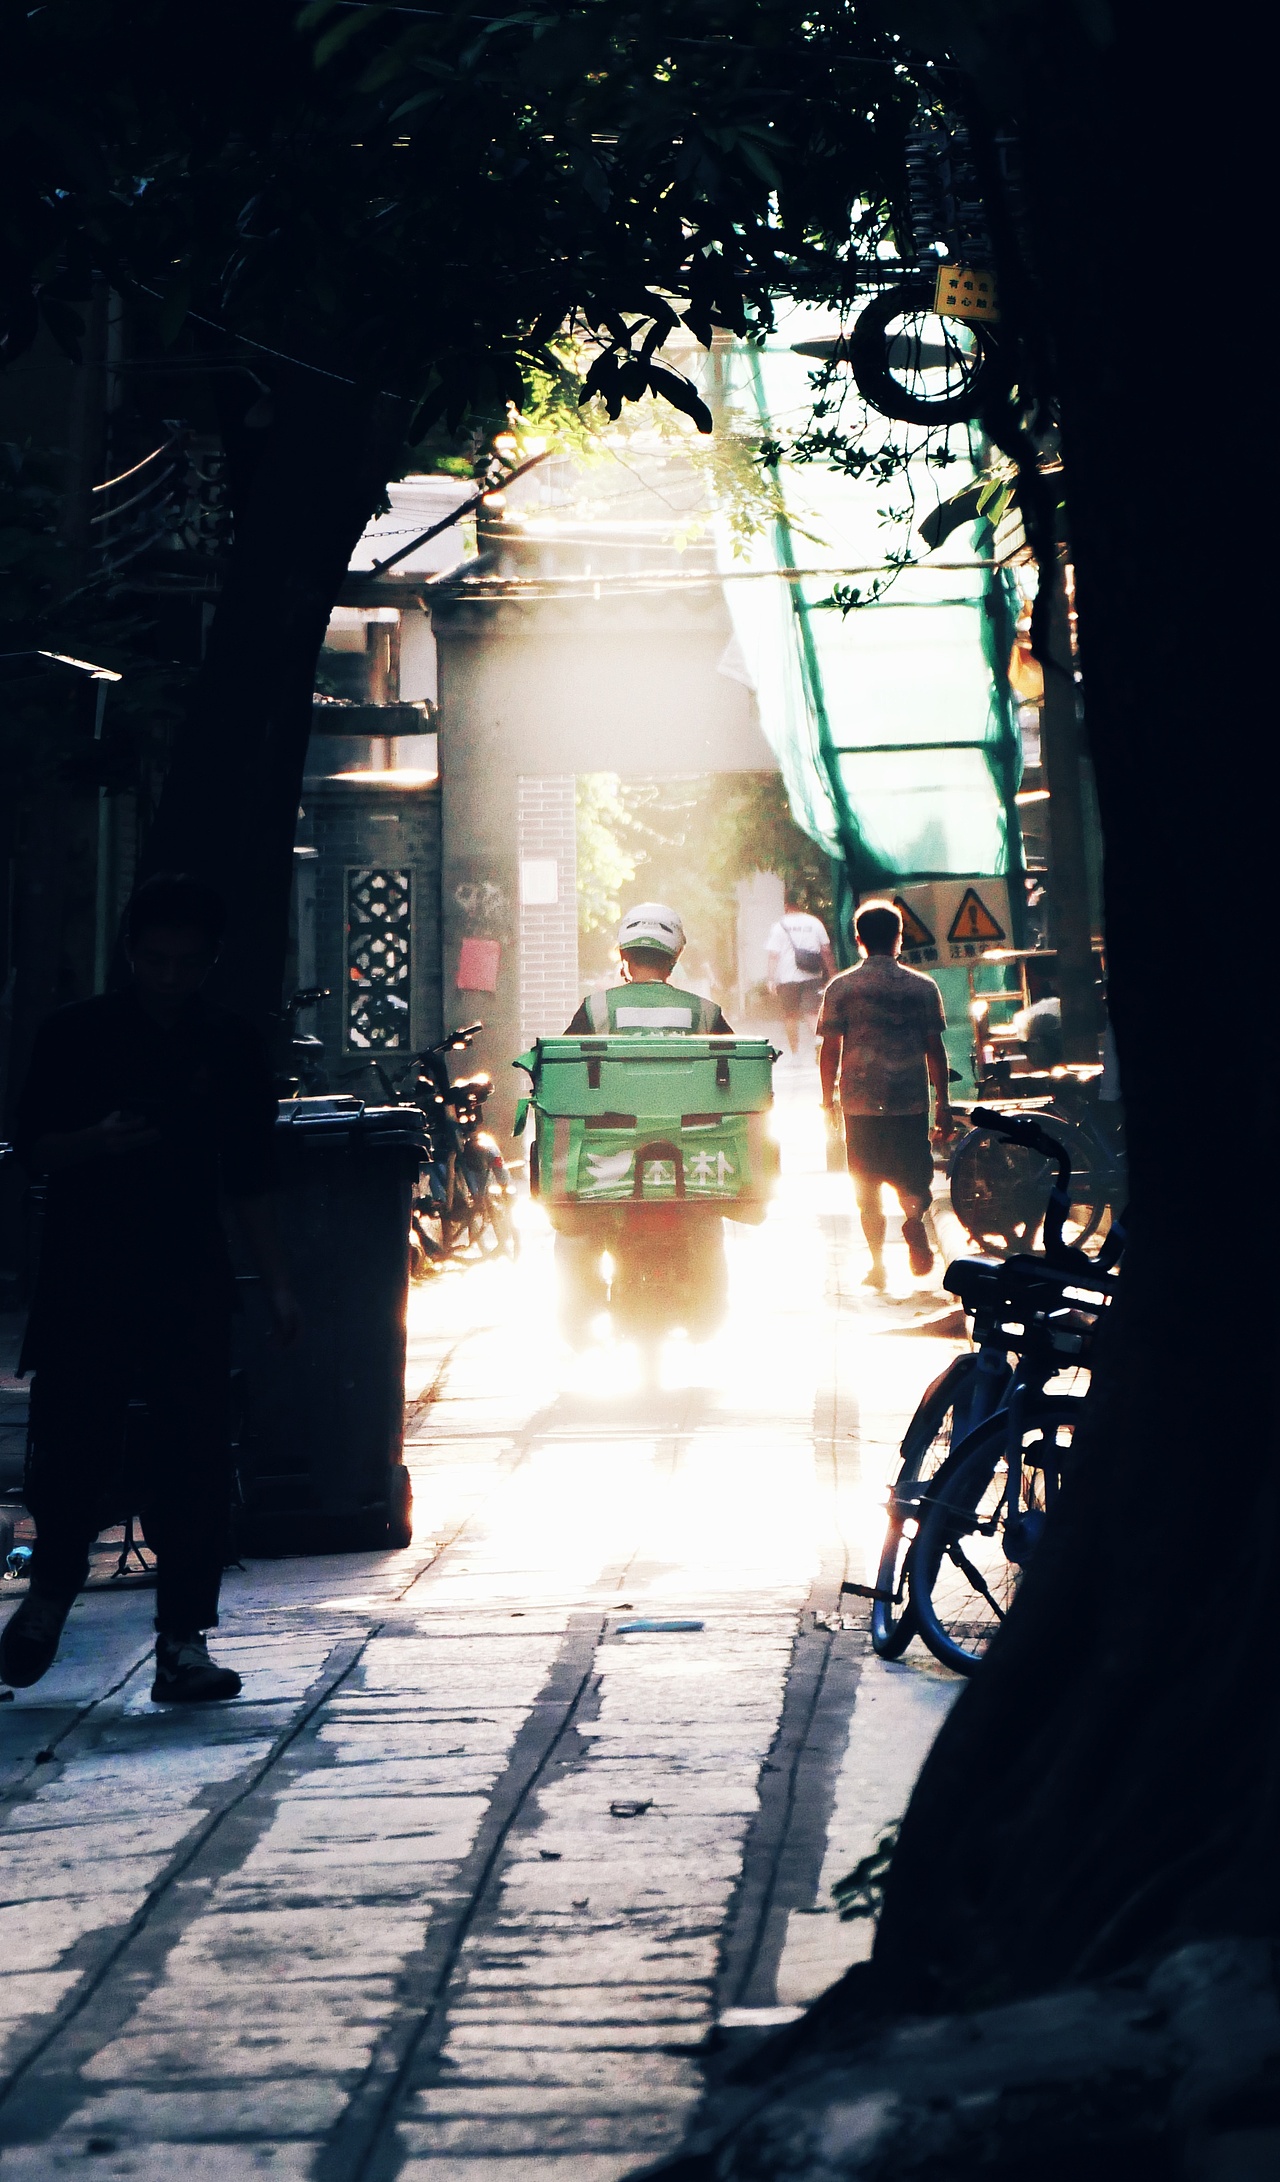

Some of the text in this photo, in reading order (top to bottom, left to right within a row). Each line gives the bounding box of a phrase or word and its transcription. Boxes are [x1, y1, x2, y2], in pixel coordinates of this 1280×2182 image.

[948, 279, 996, 292] 有电危
[946, 295, 997, 309] 当心触
